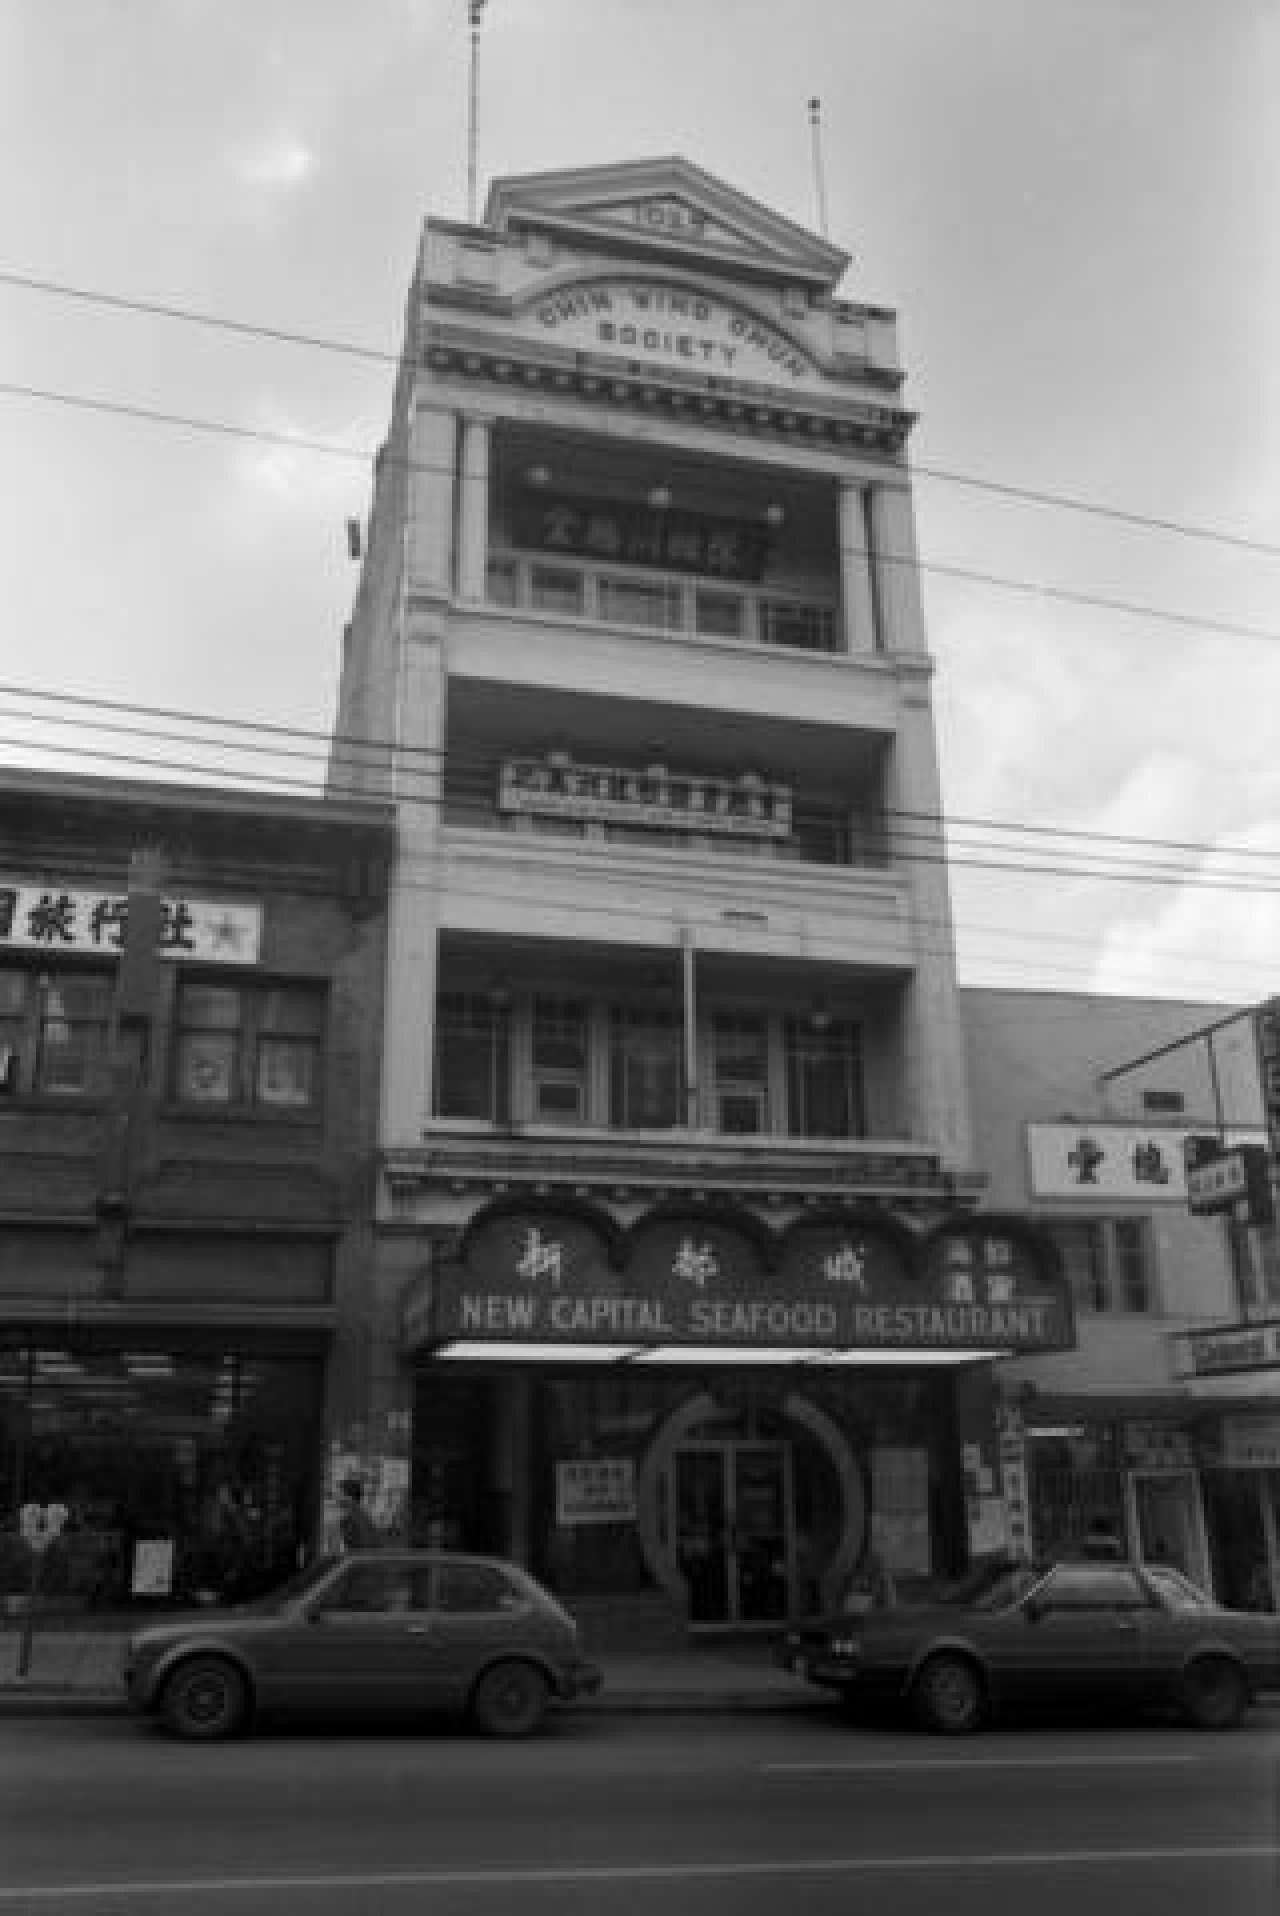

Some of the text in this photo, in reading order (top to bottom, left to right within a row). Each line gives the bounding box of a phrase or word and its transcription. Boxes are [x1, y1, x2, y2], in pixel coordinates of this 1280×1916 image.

[598, 321, 738, 367] SOCIETY
[460, 1295, 1045, 1338] NEW CAPITAL SEAFOOD RESTAURANT
